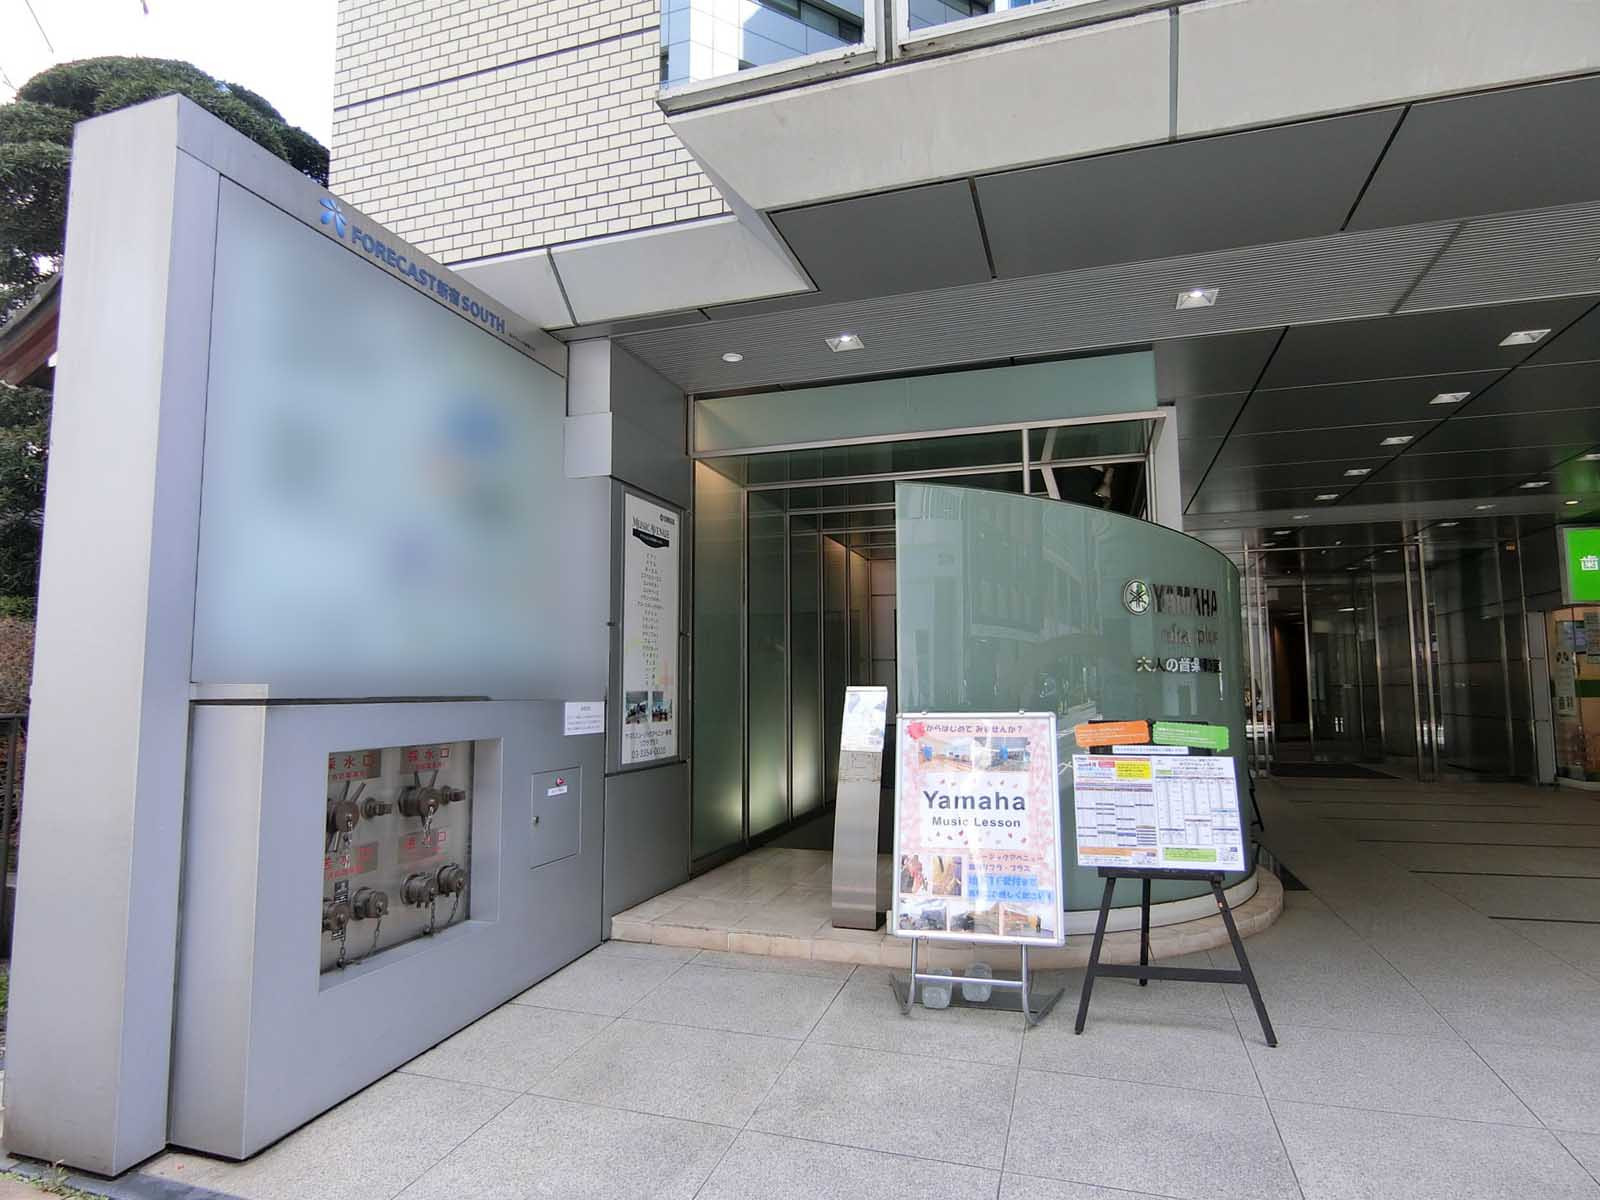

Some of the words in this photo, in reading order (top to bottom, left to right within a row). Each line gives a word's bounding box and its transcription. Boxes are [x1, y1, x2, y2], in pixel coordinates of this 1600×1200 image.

[923, 790, 1027, 811] Yamaha
[931, 816, 969, 827] Music
[974, 817, 1021, 828] Lesson
